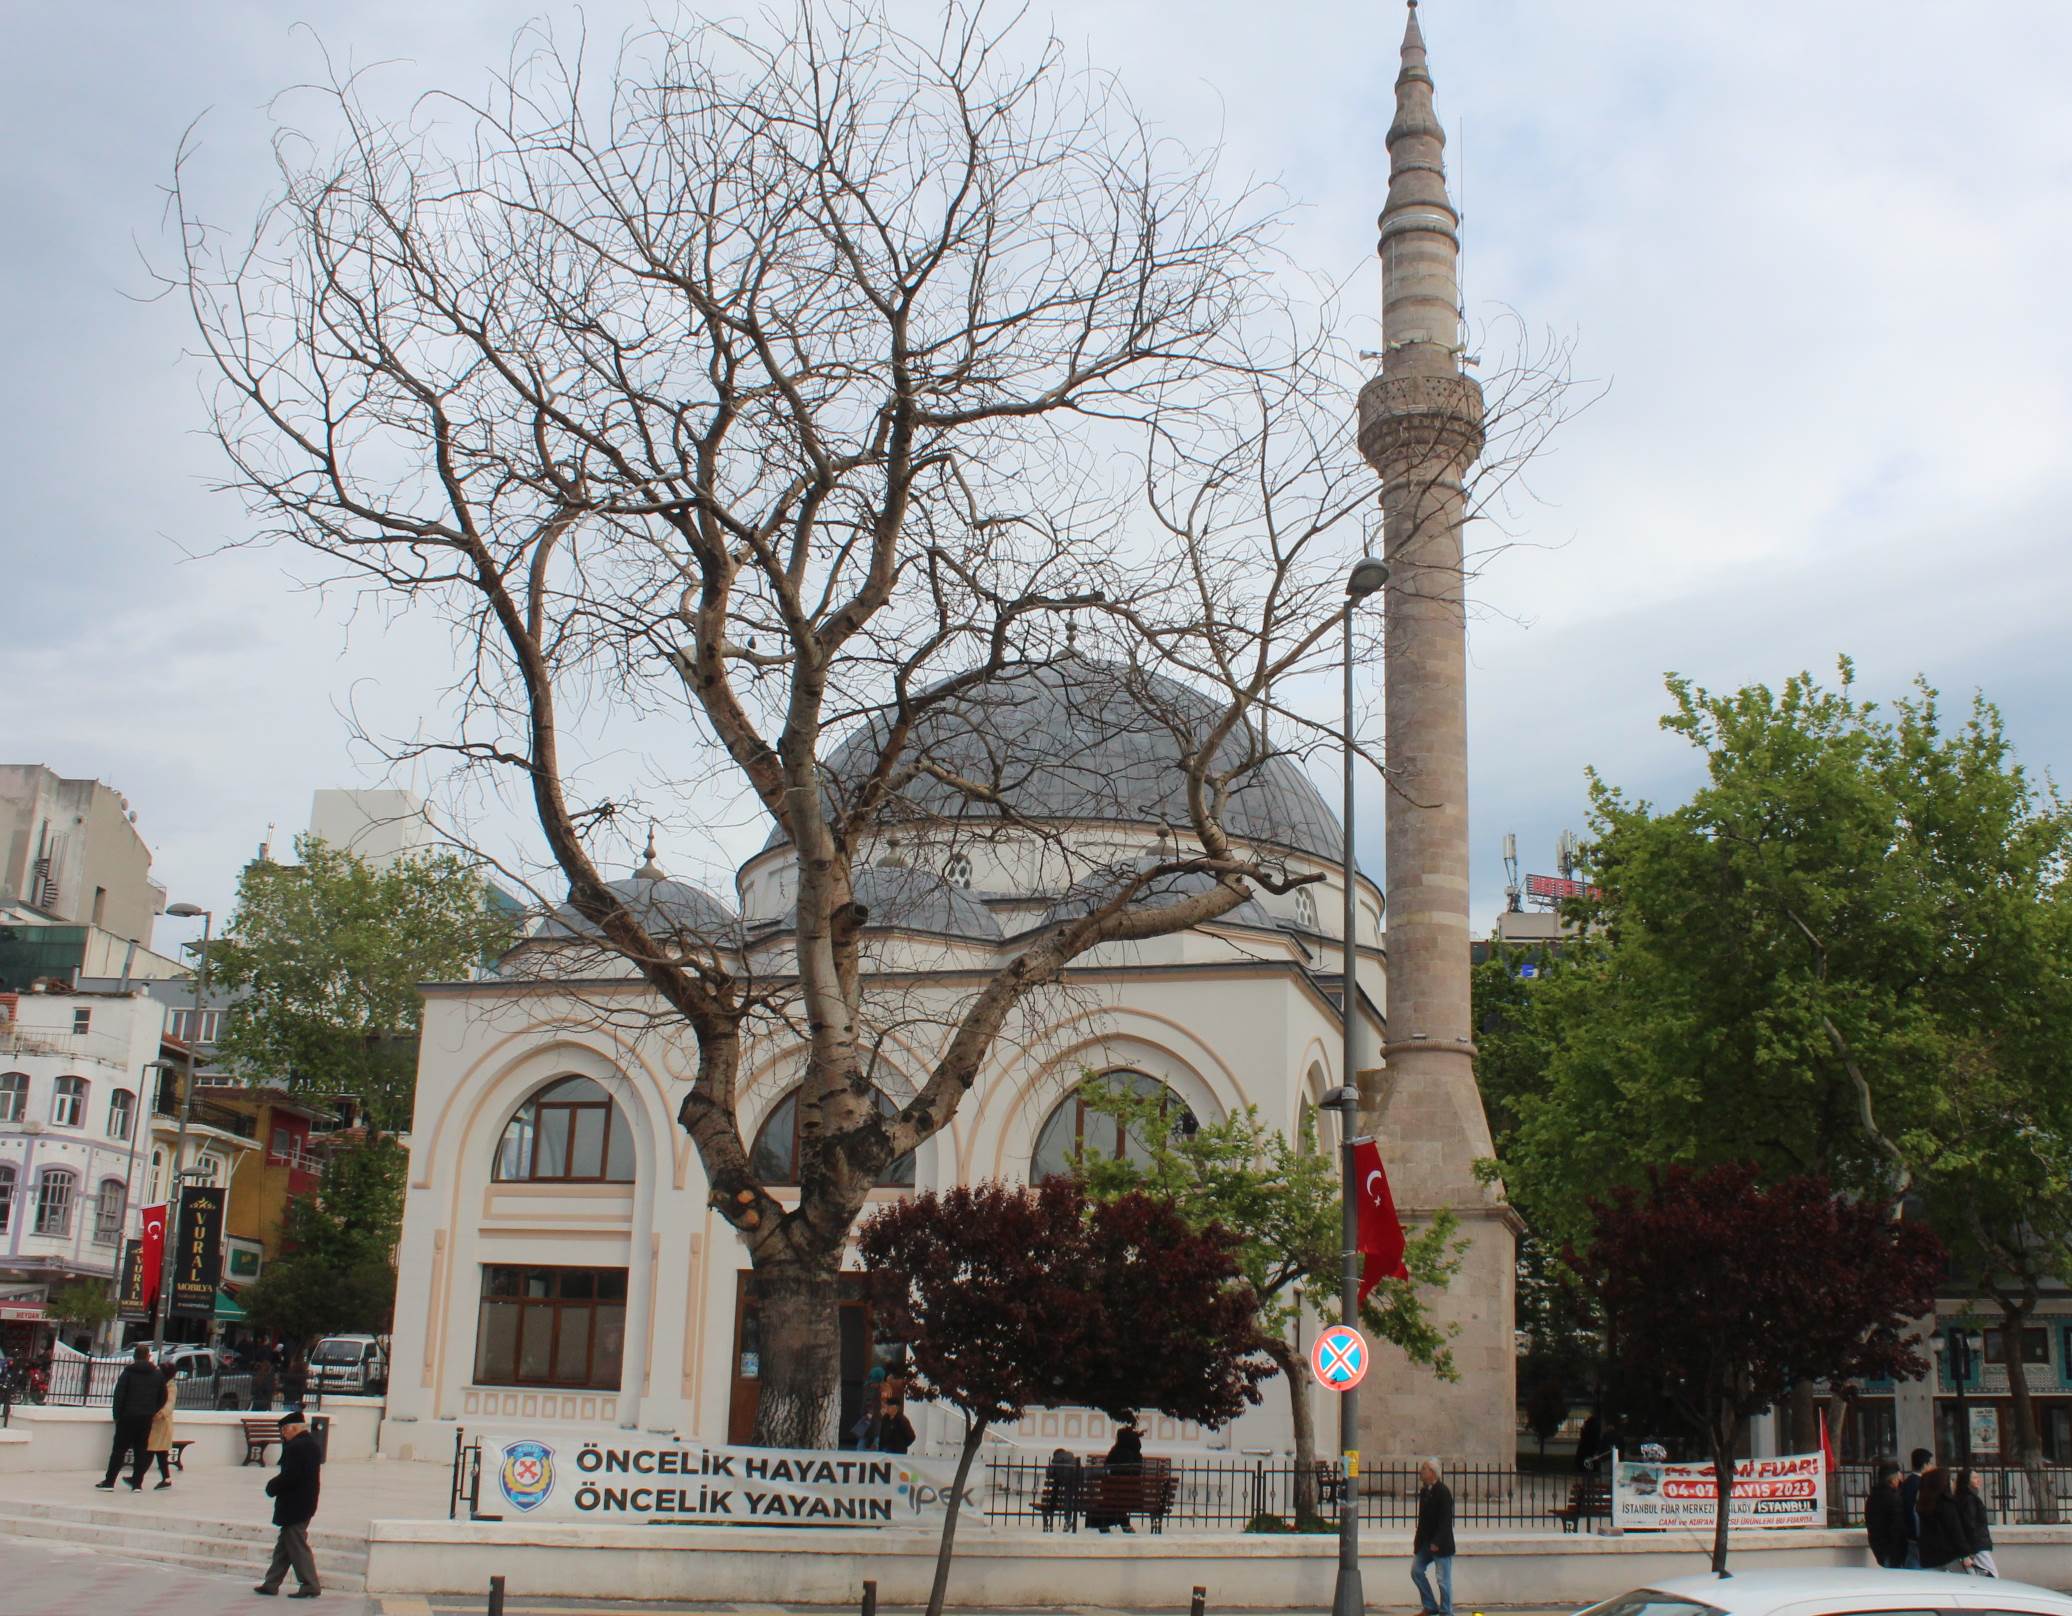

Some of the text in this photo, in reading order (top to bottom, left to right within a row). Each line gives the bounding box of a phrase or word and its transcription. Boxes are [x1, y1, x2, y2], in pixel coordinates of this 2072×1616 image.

[192, 1212, 207, 1281] VURAL
[576, 1442, 892, 1485] ÖNCELİK HAYATIN
[1758, 1457, 1818, 1478] FUARI
[574, 1481, 892, 1521] ÖNCELİK YAYANIN
[1667, 1481, 1809, 1498] 04-07 AYIS 2023
[1660, 1503, 1680, 1514] FUAR
[1757, 1500, 1813, 1513] İSTANBUL
